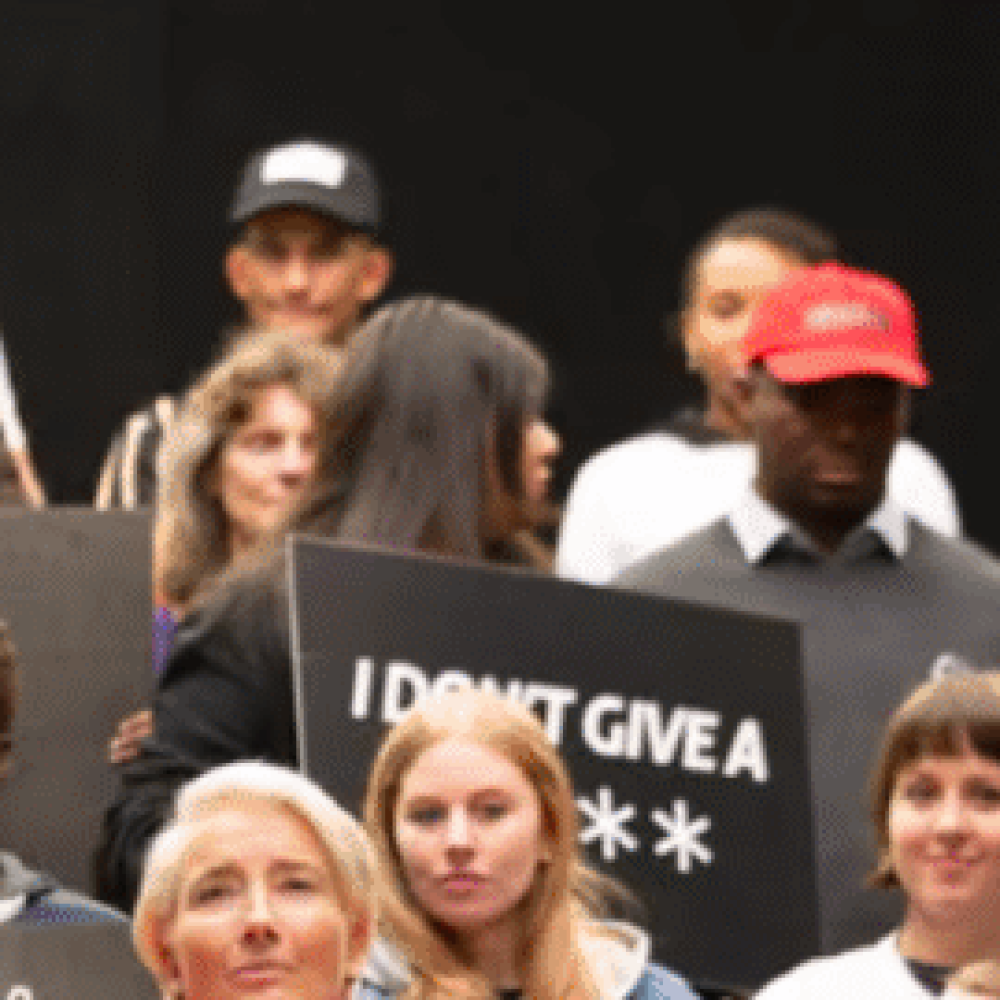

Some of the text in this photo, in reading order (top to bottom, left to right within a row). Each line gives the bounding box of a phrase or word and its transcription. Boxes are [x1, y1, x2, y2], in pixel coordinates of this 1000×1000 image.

[350, 656, 375, 720] I
[581, 693, 721, 772] GIVE
[722, 717, 770, 783] A
